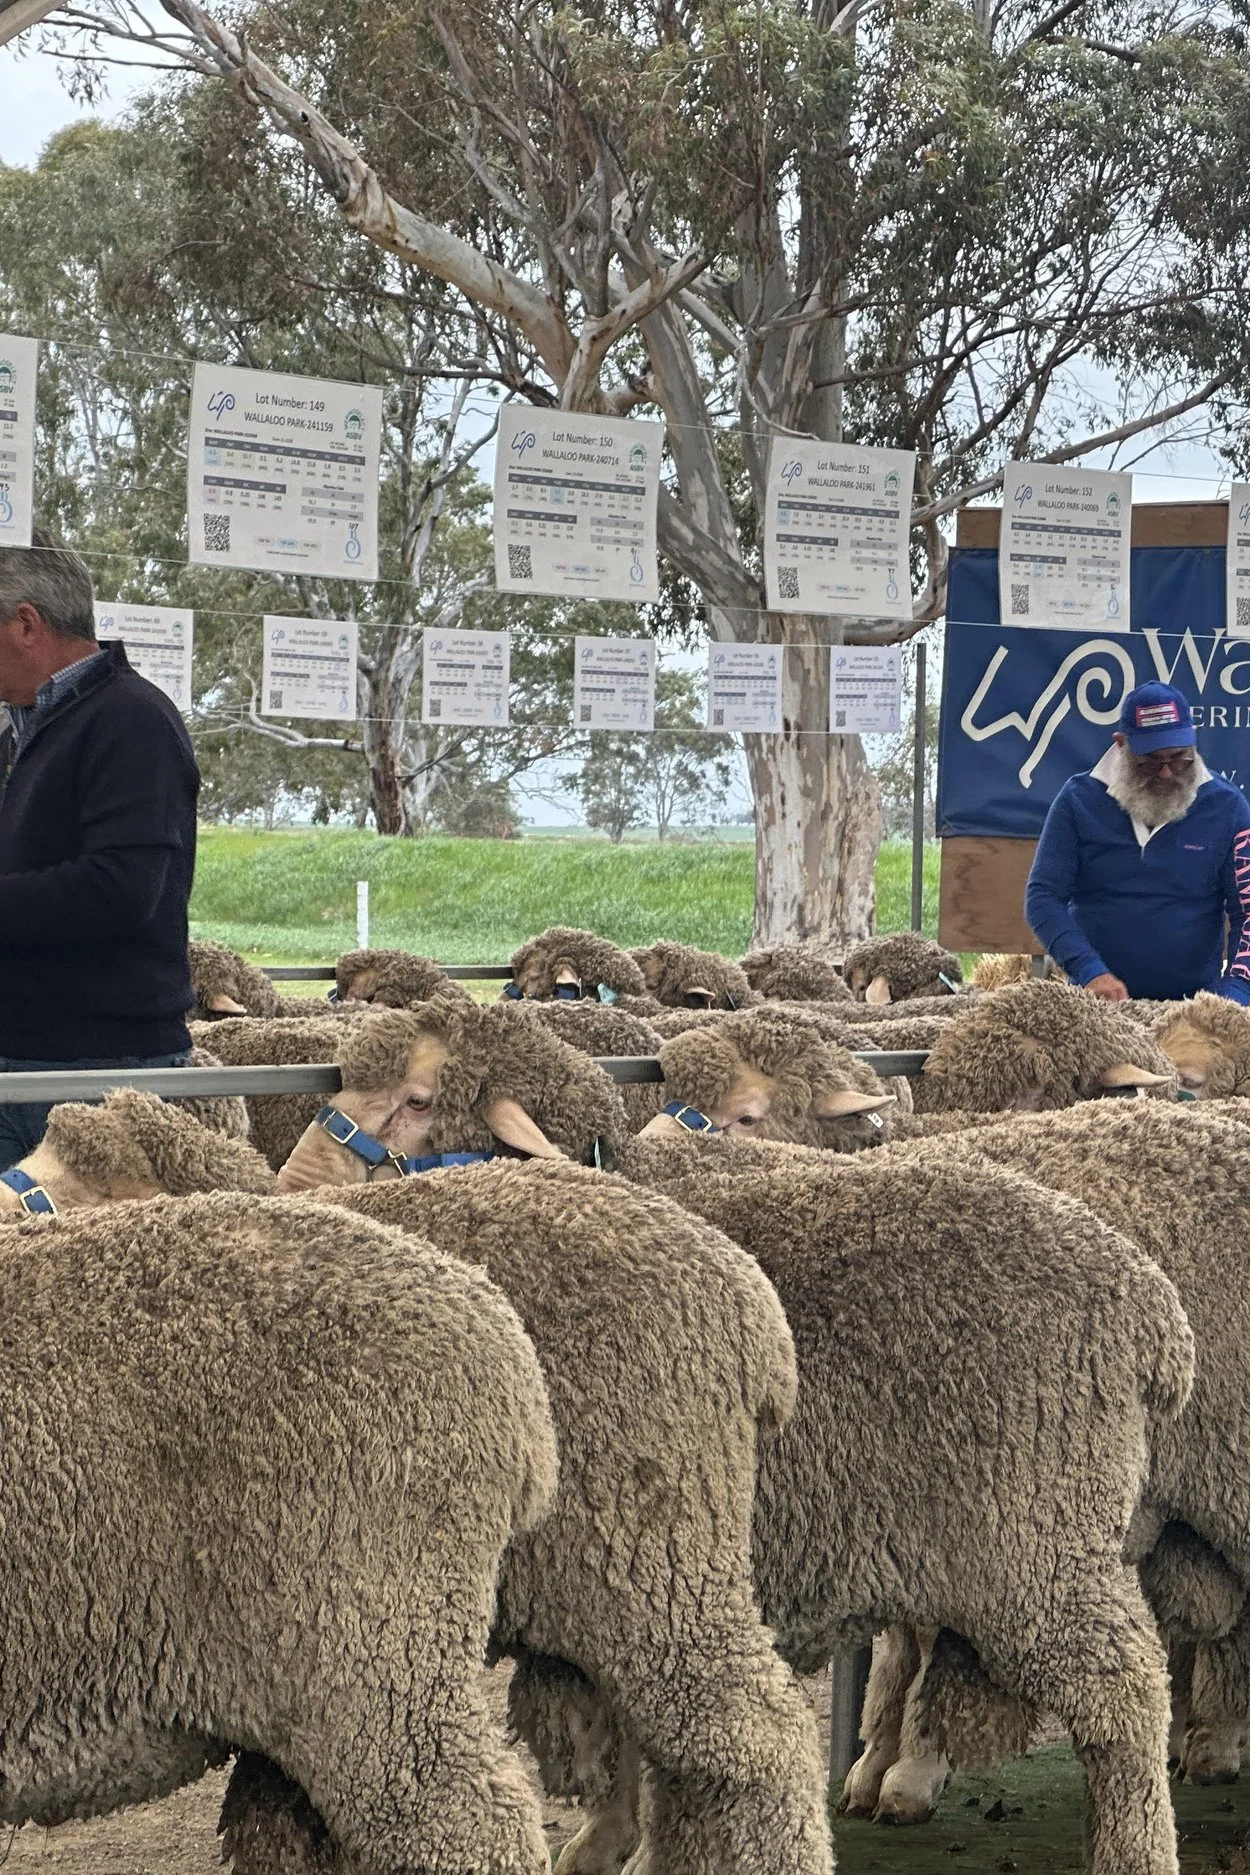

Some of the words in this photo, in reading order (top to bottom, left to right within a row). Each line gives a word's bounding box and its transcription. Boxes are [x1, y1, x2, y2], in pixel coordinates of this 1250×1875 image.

[256, 392, 269, 405] Lot
[271, 394, 308, 410] Number:
[310, 400, 325, 412] 149
[244, 412, 286, 426] WALLALOO
[287, 417, 334, 433] PARK-241159
[553, 431, 564, 442] Lot
[566, 433, 598, 446] Number:
[600, 436, 613, 448] 150
[542, 449, 578, 462] WALLALOO
[817, 460, 828, 471] Lot
[829, 462, 856, 473] Number:
[858, 464, 870, 475] 151
[808, 477, 839, 488] WALLALOO
[1045, 484, 1055, 493] Lot
[1082, 487, 1093, 497] 152
[1037, 500, 1066, 510] WALLALOO
